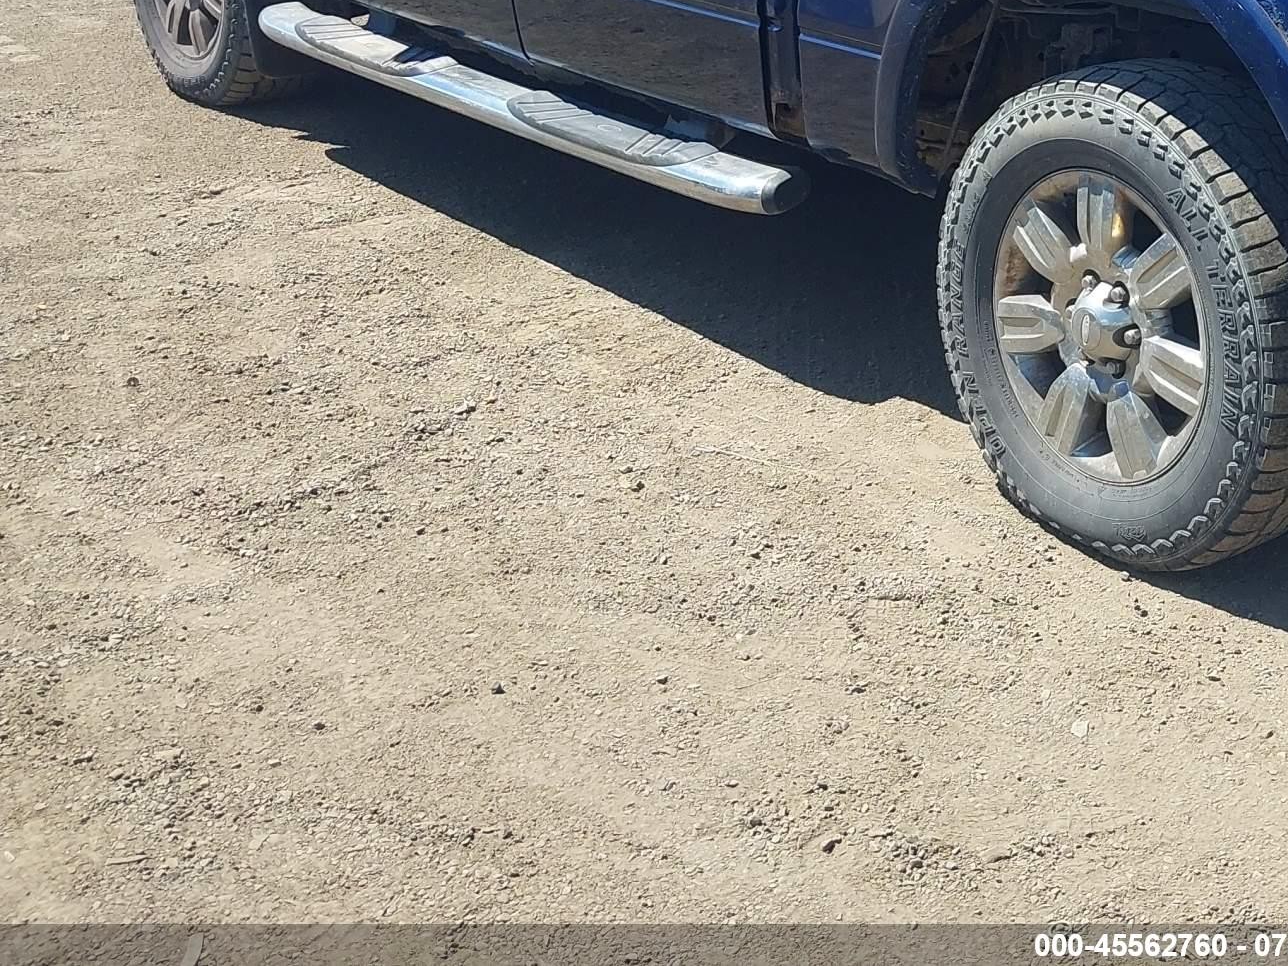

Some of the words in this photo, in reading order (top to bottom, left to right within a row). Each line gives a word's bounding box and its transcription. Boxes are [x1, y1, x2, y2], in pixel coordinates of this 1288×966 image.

[949, 236, 971, 360] RANGE
[1164, 188, 1208, 252] ALL
[1206, 258, 1243, 433] TERRAIN
